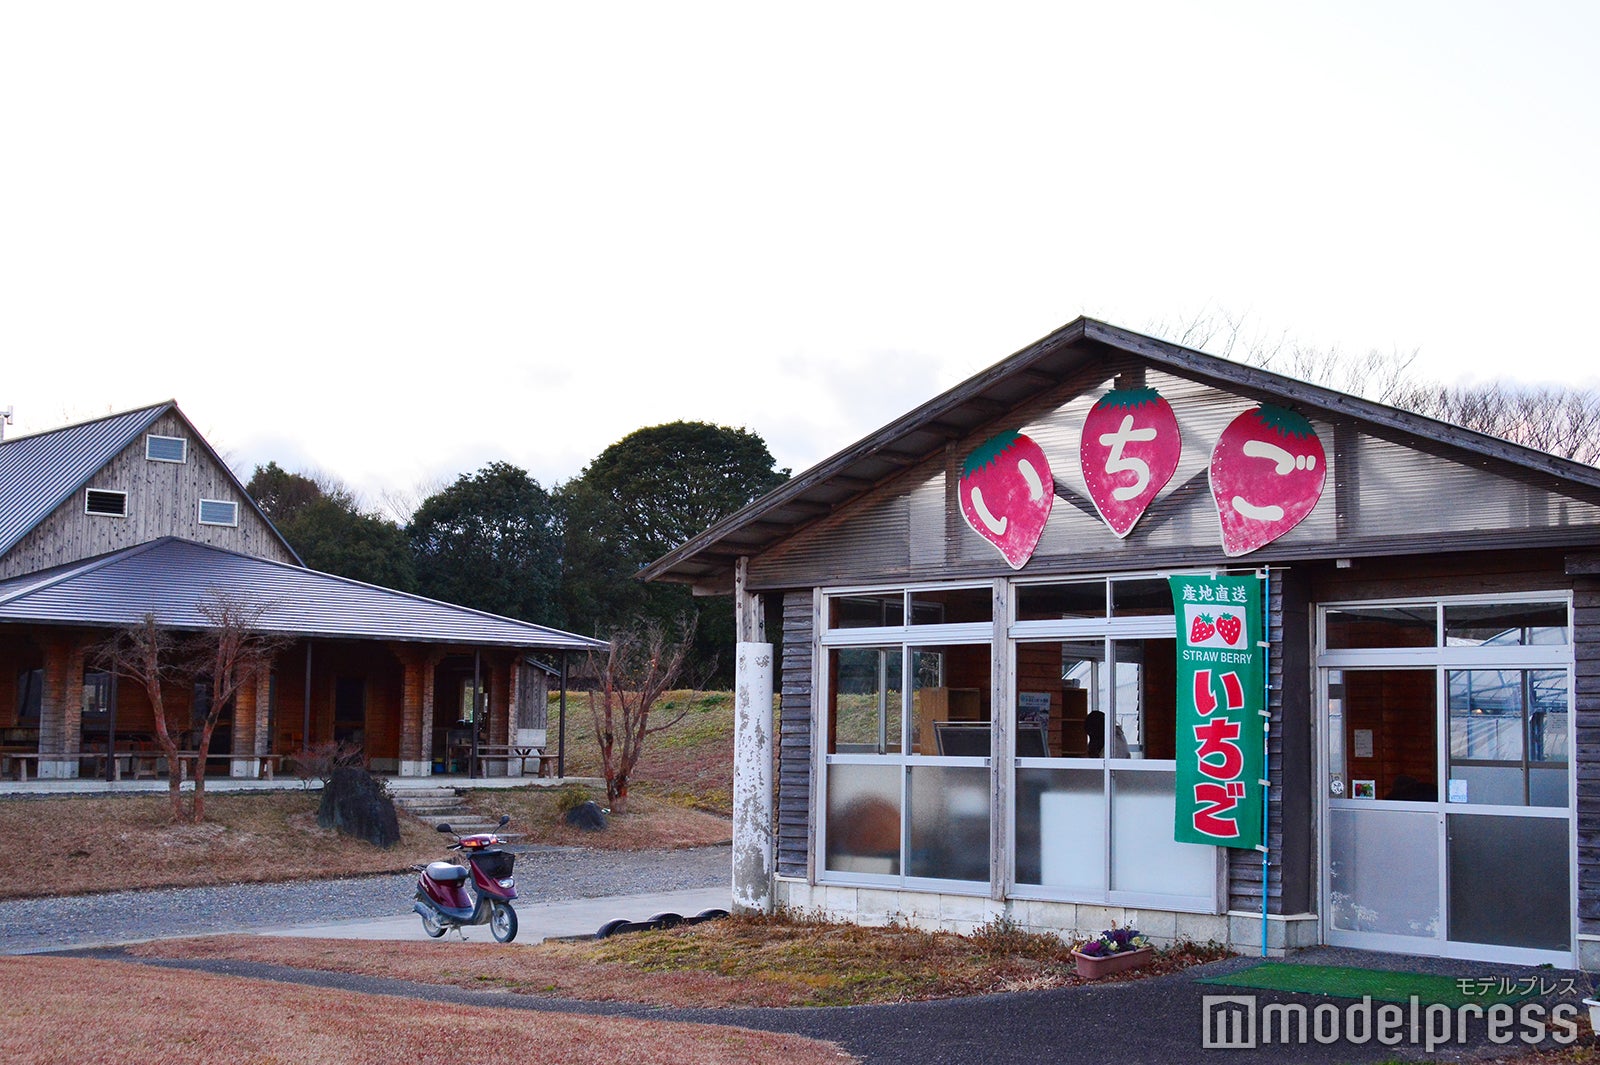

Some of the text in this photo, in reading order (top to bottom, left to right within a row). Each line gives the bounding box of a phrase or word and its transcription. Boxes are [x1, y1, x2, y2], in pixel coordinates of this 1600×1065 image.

[970, 414, 1317, 535] いちご
[1182, 583, 1248, 603] 産地直送
[1192, 668, 1246, 838] いちご
